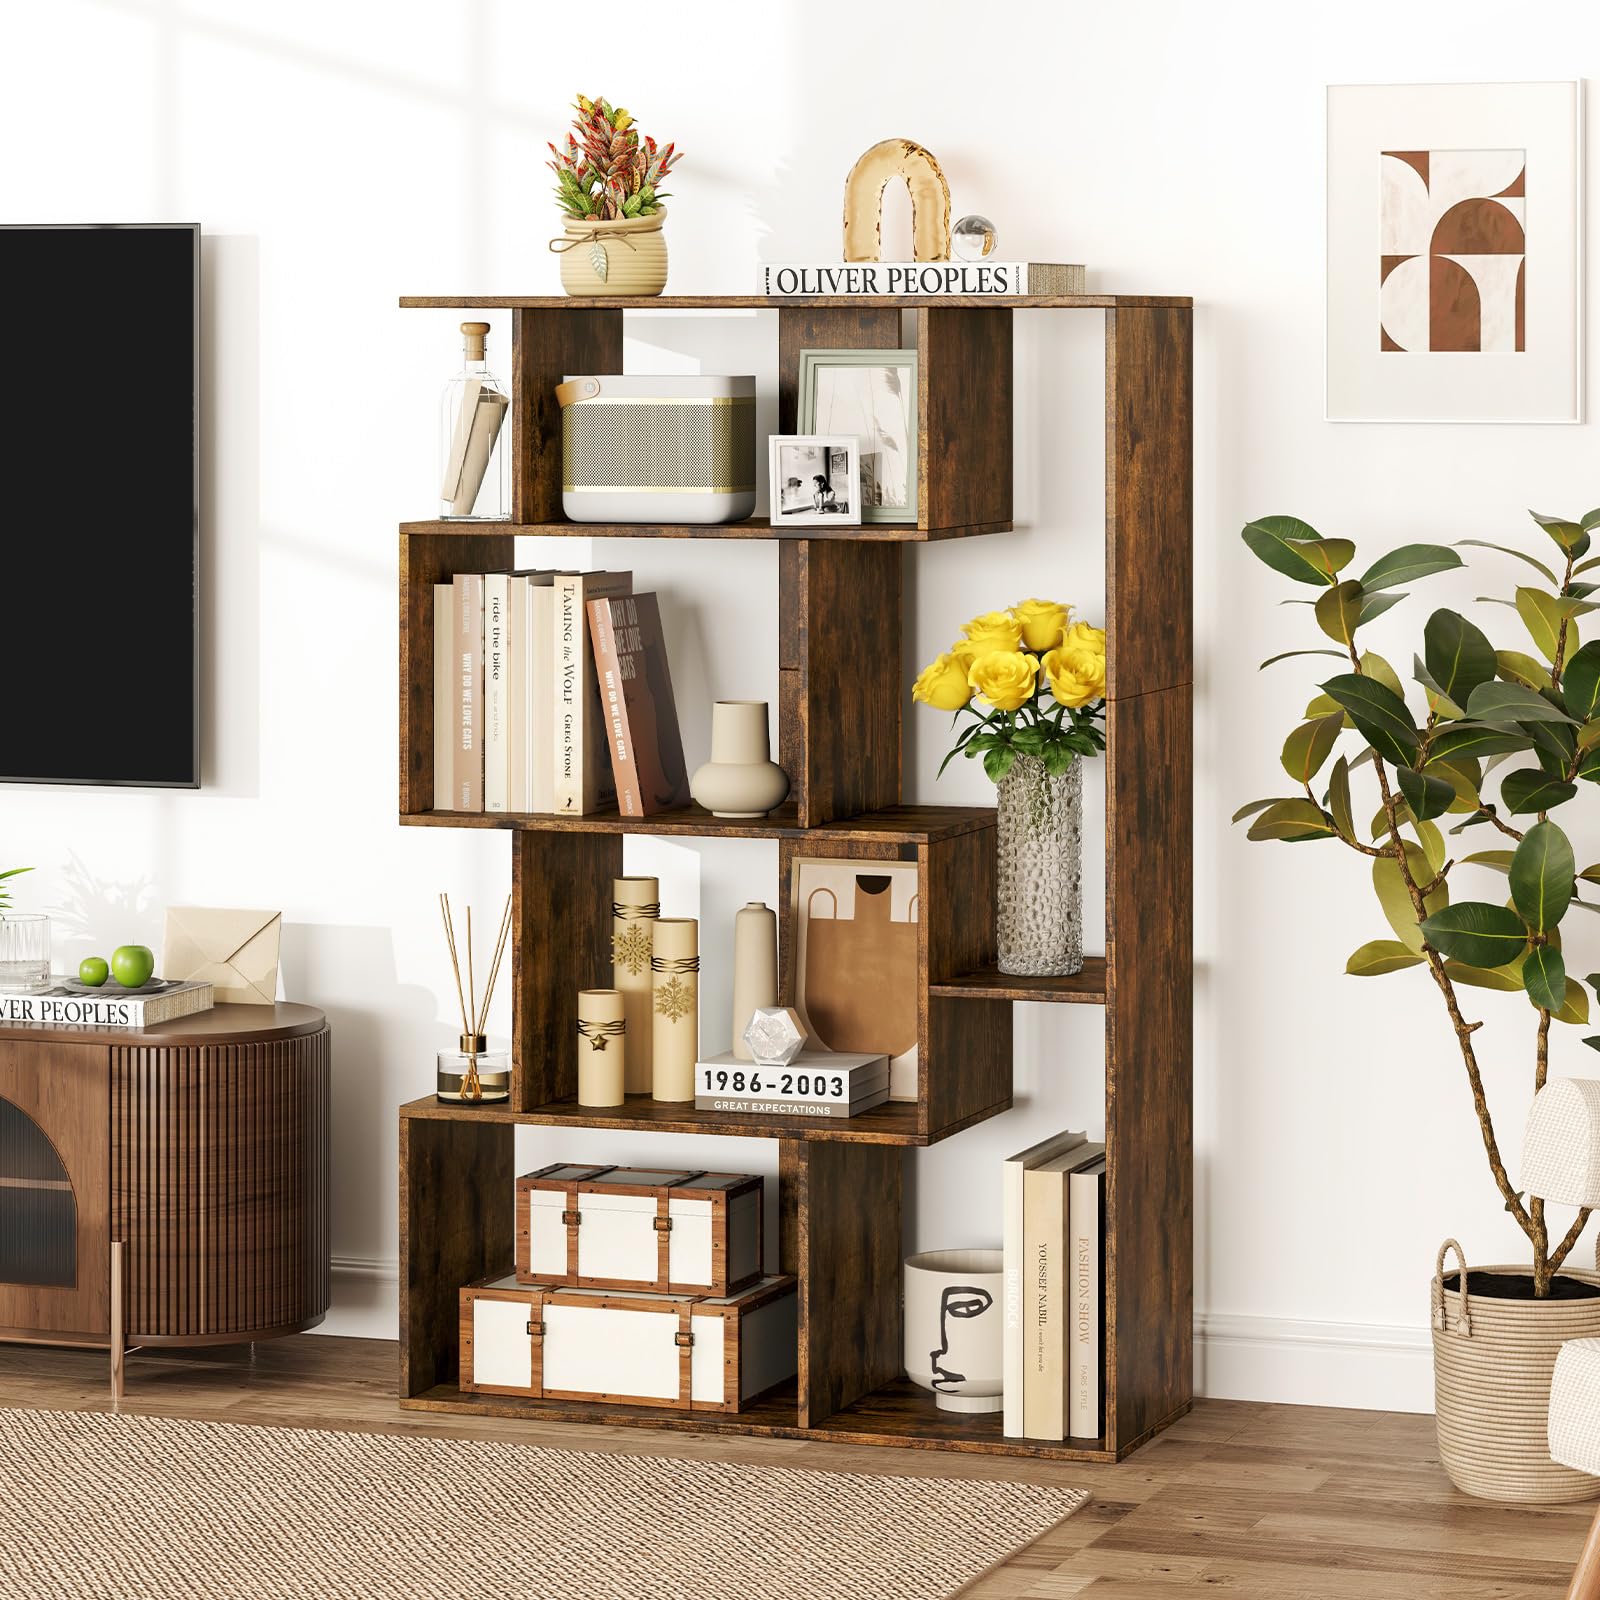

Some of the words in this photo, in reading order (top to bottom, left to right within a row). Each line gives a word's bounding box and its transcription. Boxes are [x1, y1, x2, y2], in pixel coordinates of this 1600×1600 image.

[776, 268, 879, 294] OLIVER
[887, 267, 1008, 294] PEOPLES
[491, 597, 501, 624] ride
[563, 584, 576, 642] TAMING
[610, 599, 627, 627] WHY
[625, 599, 638, 626] DO
[491, 627, 501, 648] the
[625, 627, 643, 652] LOVE
[462, 653, 473, 673] WHY
[563, 646, 573, 662] the
[491, 652, 501, 681] bike
[462, 675, 473, 687] DO
[563, 664, 576, 705] WOLF
[604, 670, 616, 690] WHY
[462, 689, 473, 703] WE
[608, 691, 618, 702] DO
[462, 704, 473, 726] LOVE
[610, 704, 621, 718] WE
[462, 728, 473, 750] CATS
[563, 714, 574, 744] GREG
[612, 719, 624, 739] LOVE
[614, 739, 627, 761] CATS
[563, 745, 574, 779] STONE
[40, 1001, 129, 1025] PEOPLES
[704, 1070, 844, 1097] 1986-2003
[714, 1100, 748, 1111] GREAT
[752, 1103, 831, 1115] EXPECTATIONS
[1038, 1243, 1048, 1292] YOUSSEF
[1078, 1237, 1090, 1299] FASHION
[1038, 1293, 1048, 1327] NABIL
[1078, 1302, 1090, 1344] SHOW
[1080, 1365, 1088, 1386] PARIS
[1080, 1389, 1088, 1410] STYLE
